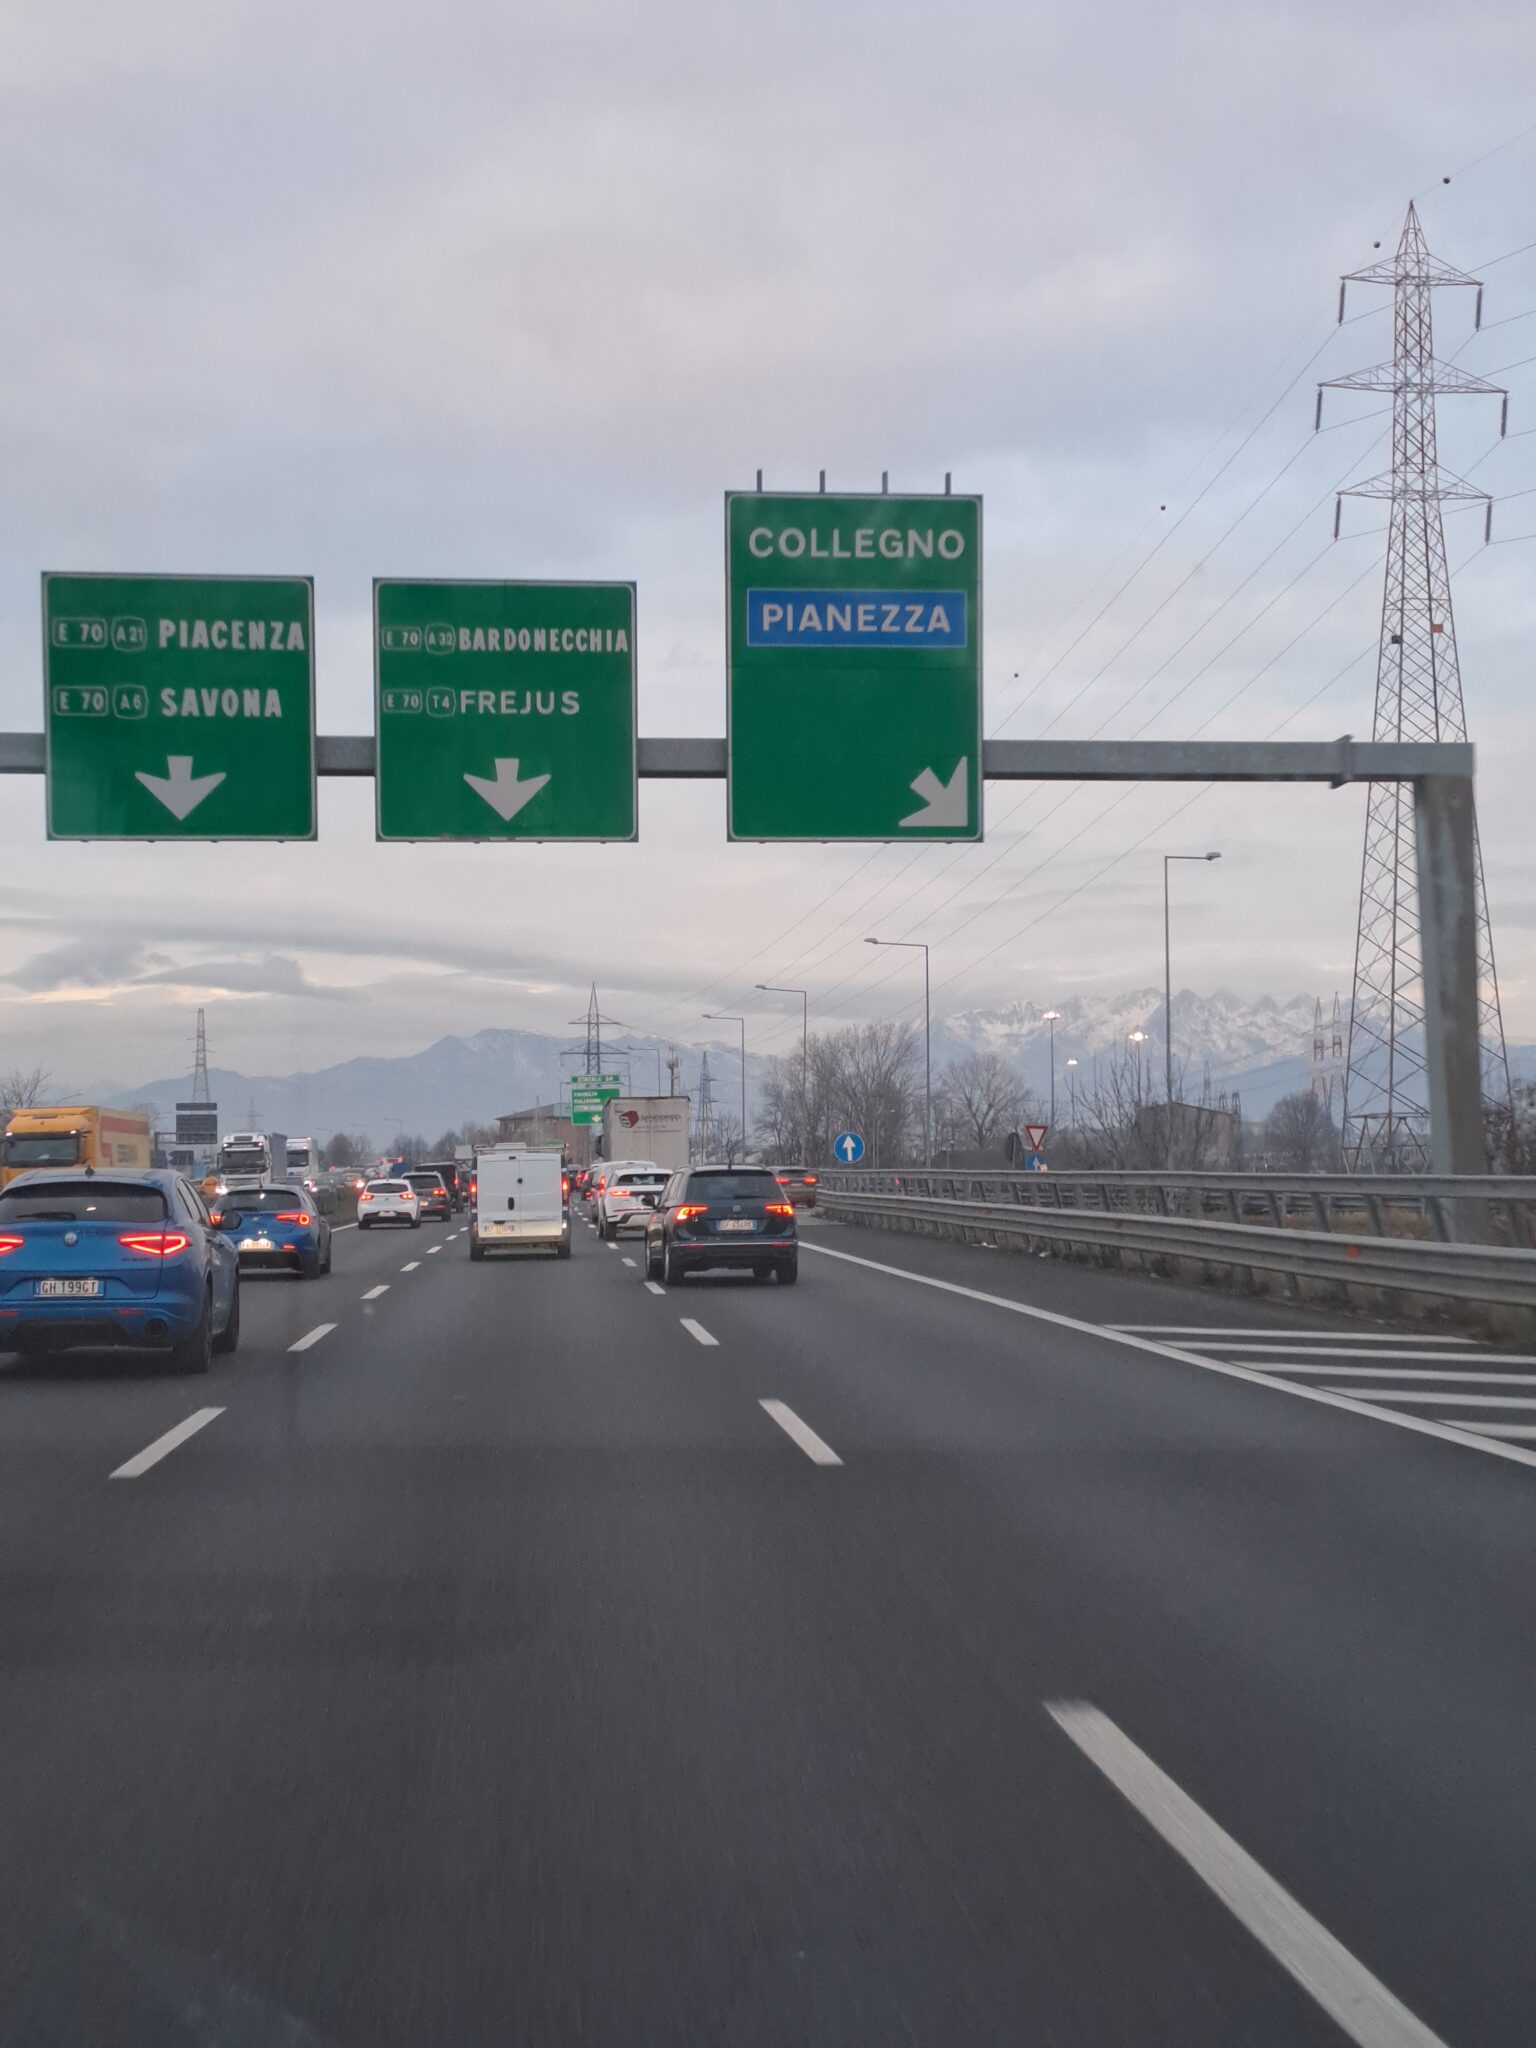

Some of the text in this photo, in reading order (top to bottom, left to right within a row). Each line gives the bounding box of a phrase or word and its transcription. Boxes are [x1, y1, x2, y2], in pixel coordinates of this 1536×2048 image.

[749, 527, 965, 560] COLLEGNO
[762, 603, 951, 633] PIANEZZA
[59, 623, 68, 642] E
[80, 623, 103, 642] 70
[159, 619, 305, 650] PIACENZA
[386, 631, 394, 646] E
[402, 631, 419, 646] 70
[458, 627, 628, 652] BARDONECCHIA
[60, 691, 69, 710] E
[81, 692, 105, 711] 70
[160, 687, 283, 717] SAVONA
[387, 693, 394, 708] E
[402, 693, 420, 709] 70
[460, 690, 580, 715] FREJUS
[42, 1282, 57, 1294] GH
